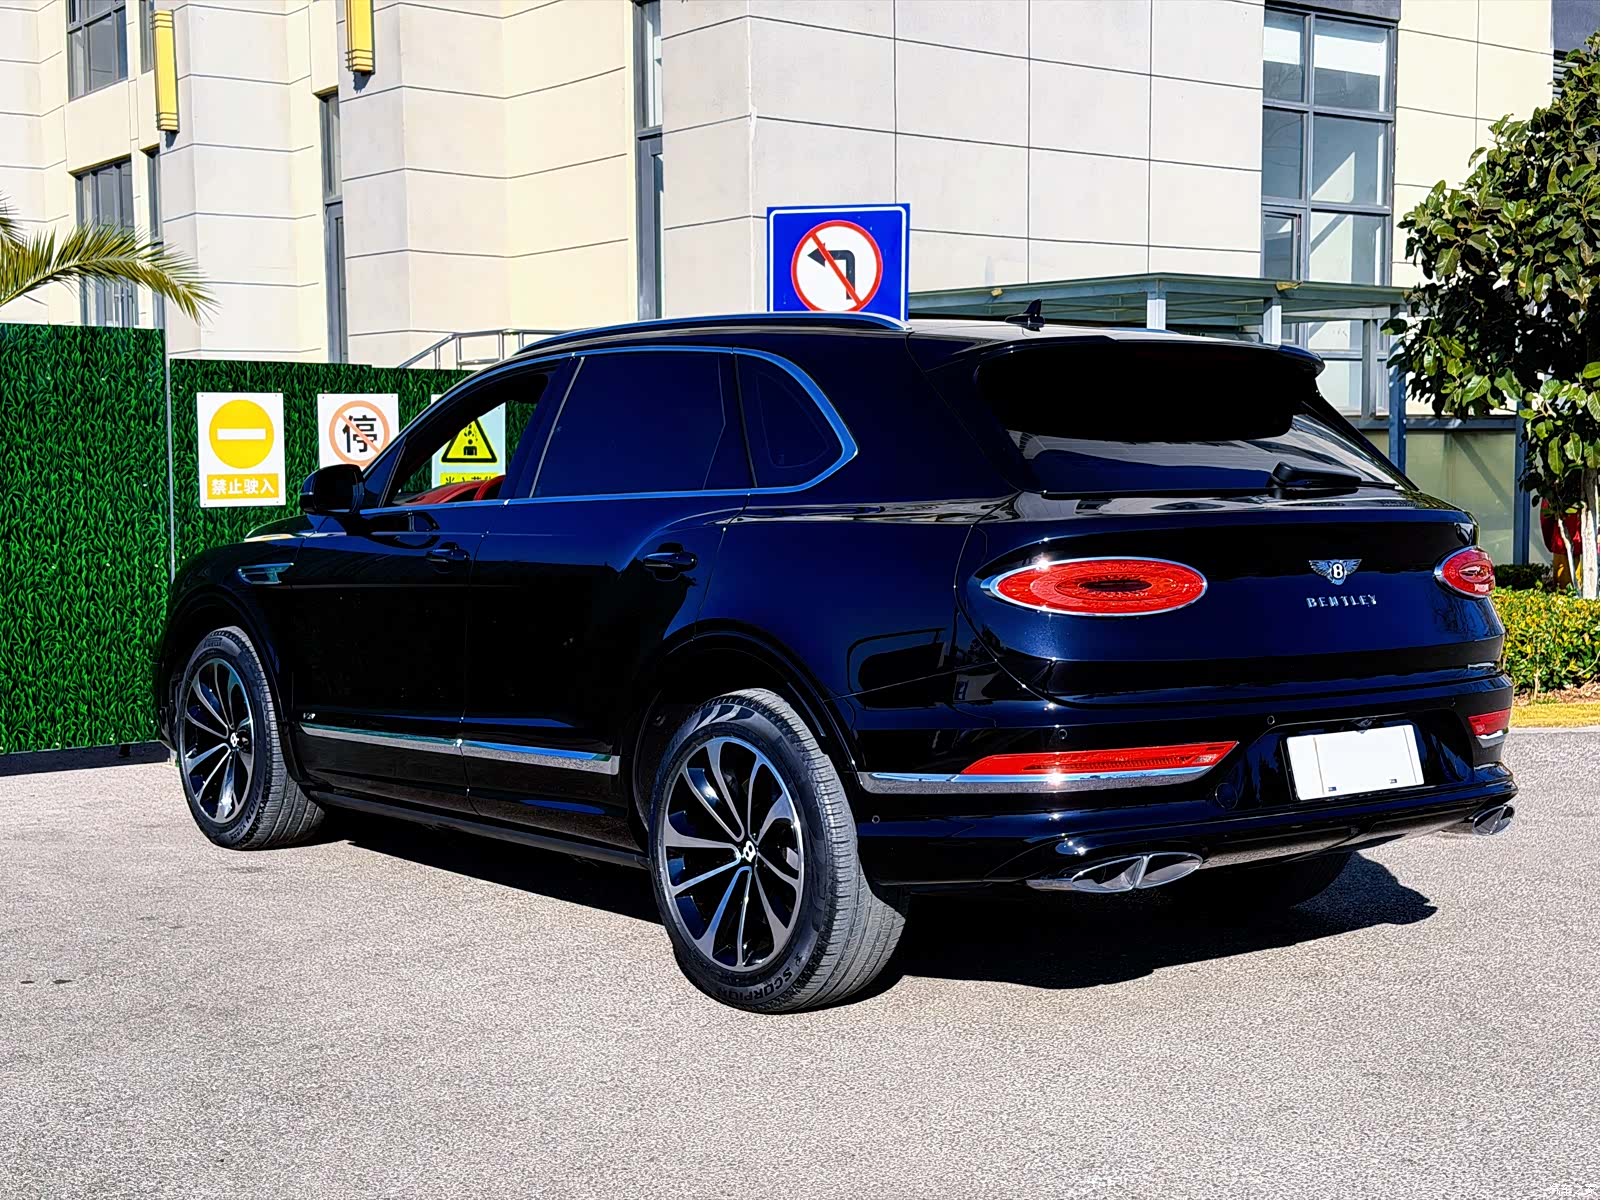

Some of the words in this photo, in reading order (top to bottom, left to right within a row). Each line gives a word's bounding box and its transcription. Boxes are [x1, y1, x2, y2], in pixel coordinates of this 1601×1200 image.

[342, 414, 377, 453] 停
[211, 477, 275, 496] 禁止驶入
[1306, 594, 1377, 608] BENTLEY
[716, 967, 793, 1001] SCORPION
